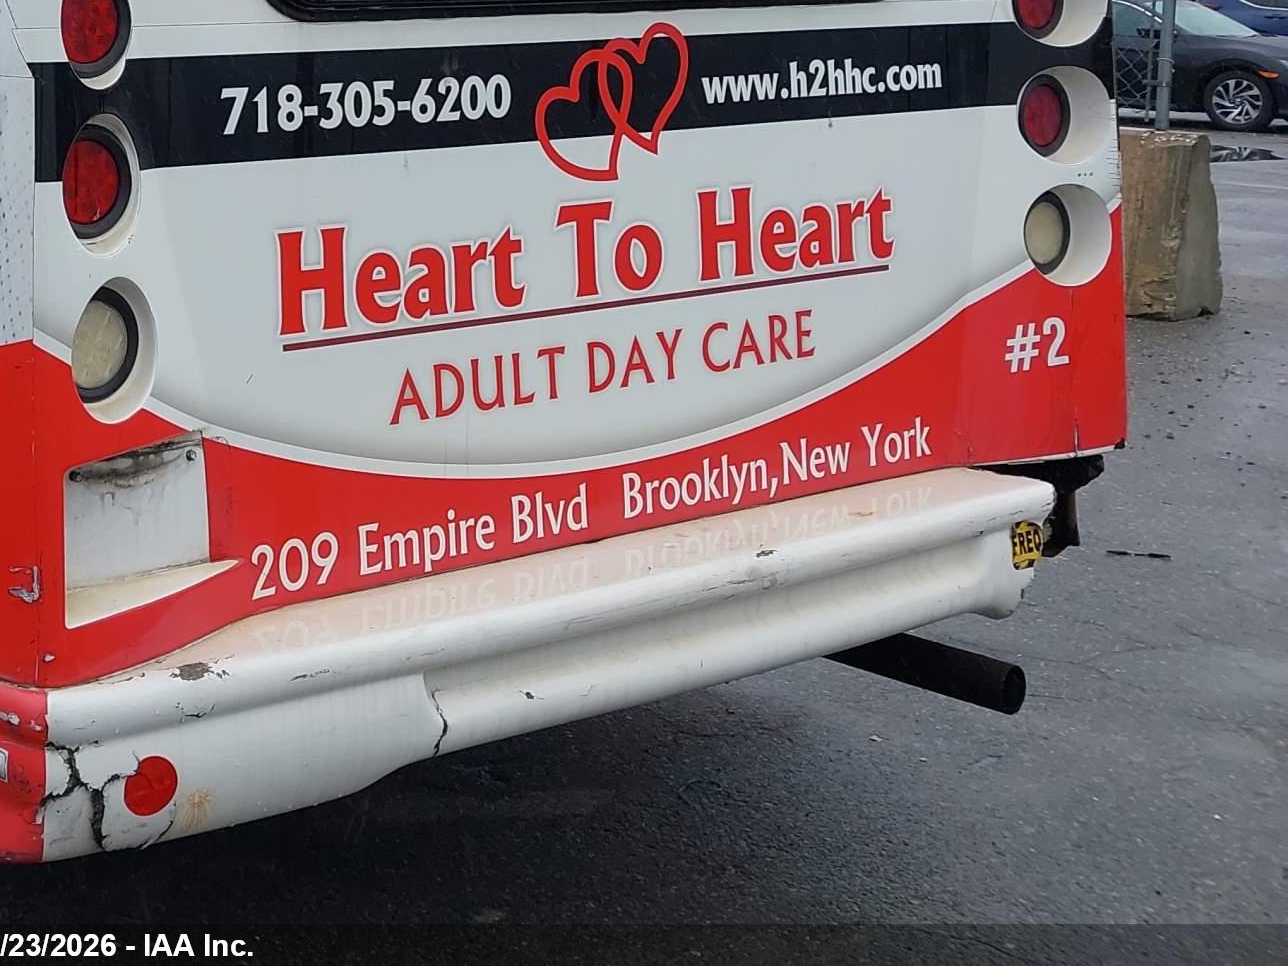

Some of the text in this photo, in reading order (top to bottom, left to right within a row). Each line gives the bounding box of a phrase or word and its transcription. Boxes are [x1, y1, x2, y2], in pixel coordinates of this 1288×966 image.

[220, 74, 513, 136] 718-305-6200
[701, 58, 943, 105] www.h2hhc.com
[275, 185, 895, 336] Heart To Heart
[389, 308, 817, 426] ADULT DAY CARE
[1003, 315, 1070, 373] #2
[251, 531, 339, 601] 209
[357, 509, 496, 576] Empire
[510, 482, 589, 544] Blvd
[861, 416, 932, 468] York
